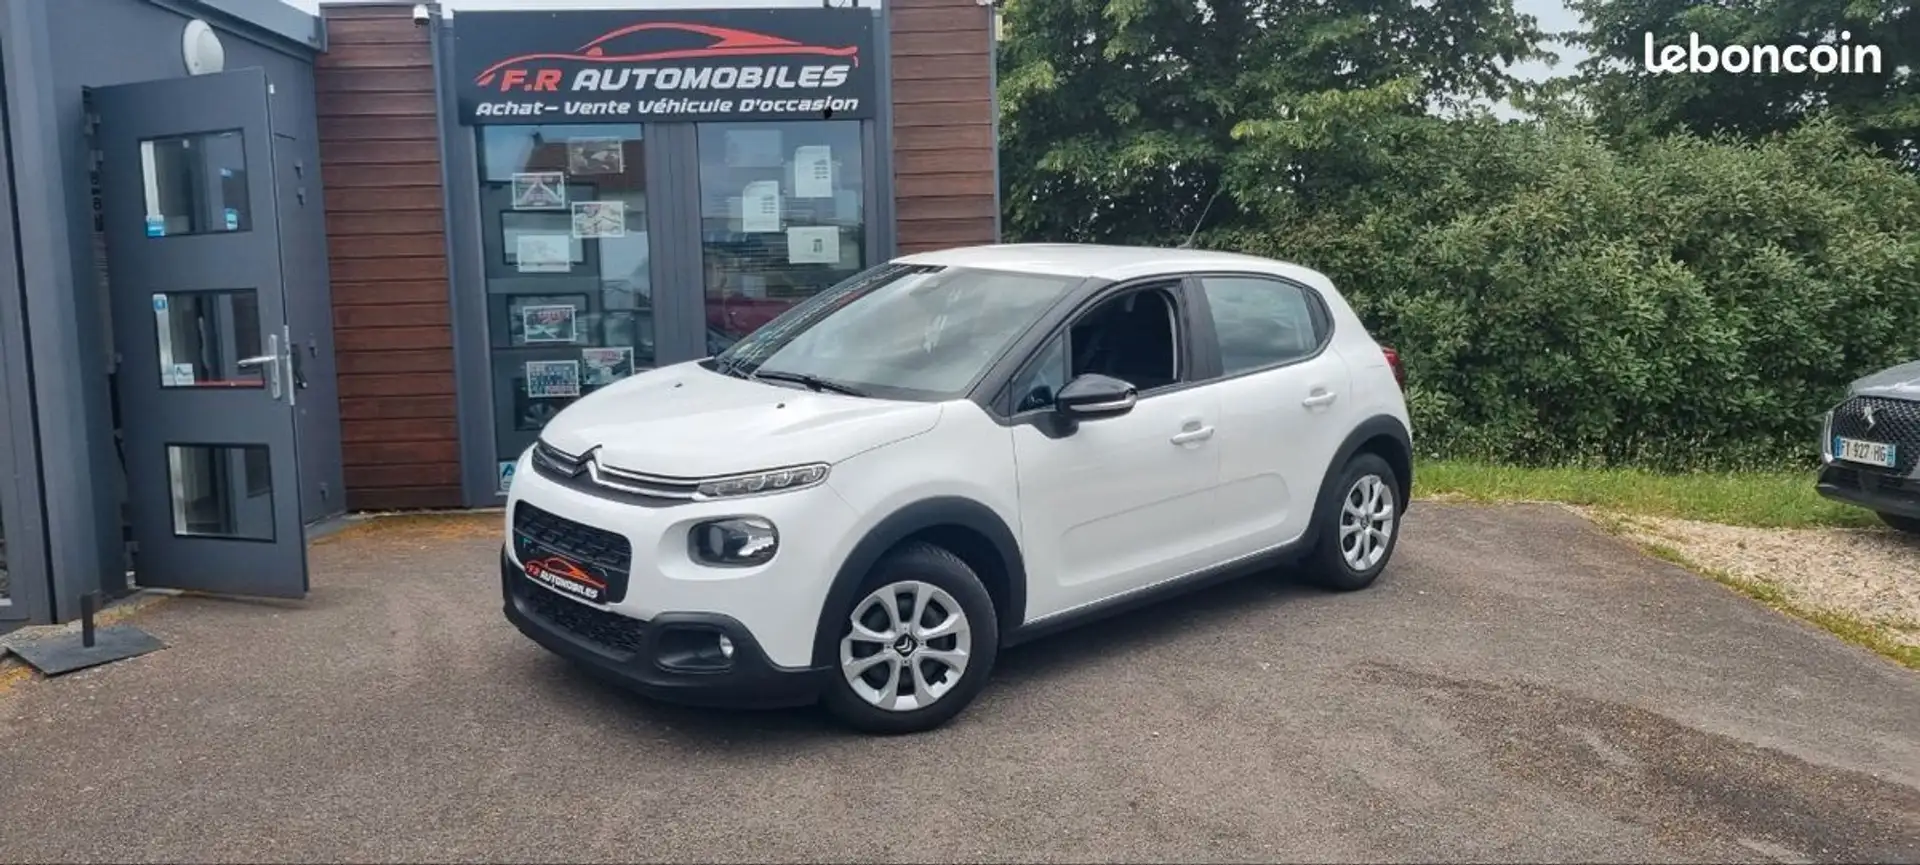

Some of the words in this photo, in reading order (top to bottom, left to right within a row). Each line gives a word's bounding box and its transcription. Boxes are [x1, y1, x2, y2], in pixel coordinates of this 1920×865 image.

[500, 68, 563, 92] F.R
[571, 65, 850, 92] AUTOMOBILES
[564, 99, 631, 116] Vente
[637, 97, 734, 114] Véhicule
[738, 96, 859, 113] D'occasion
